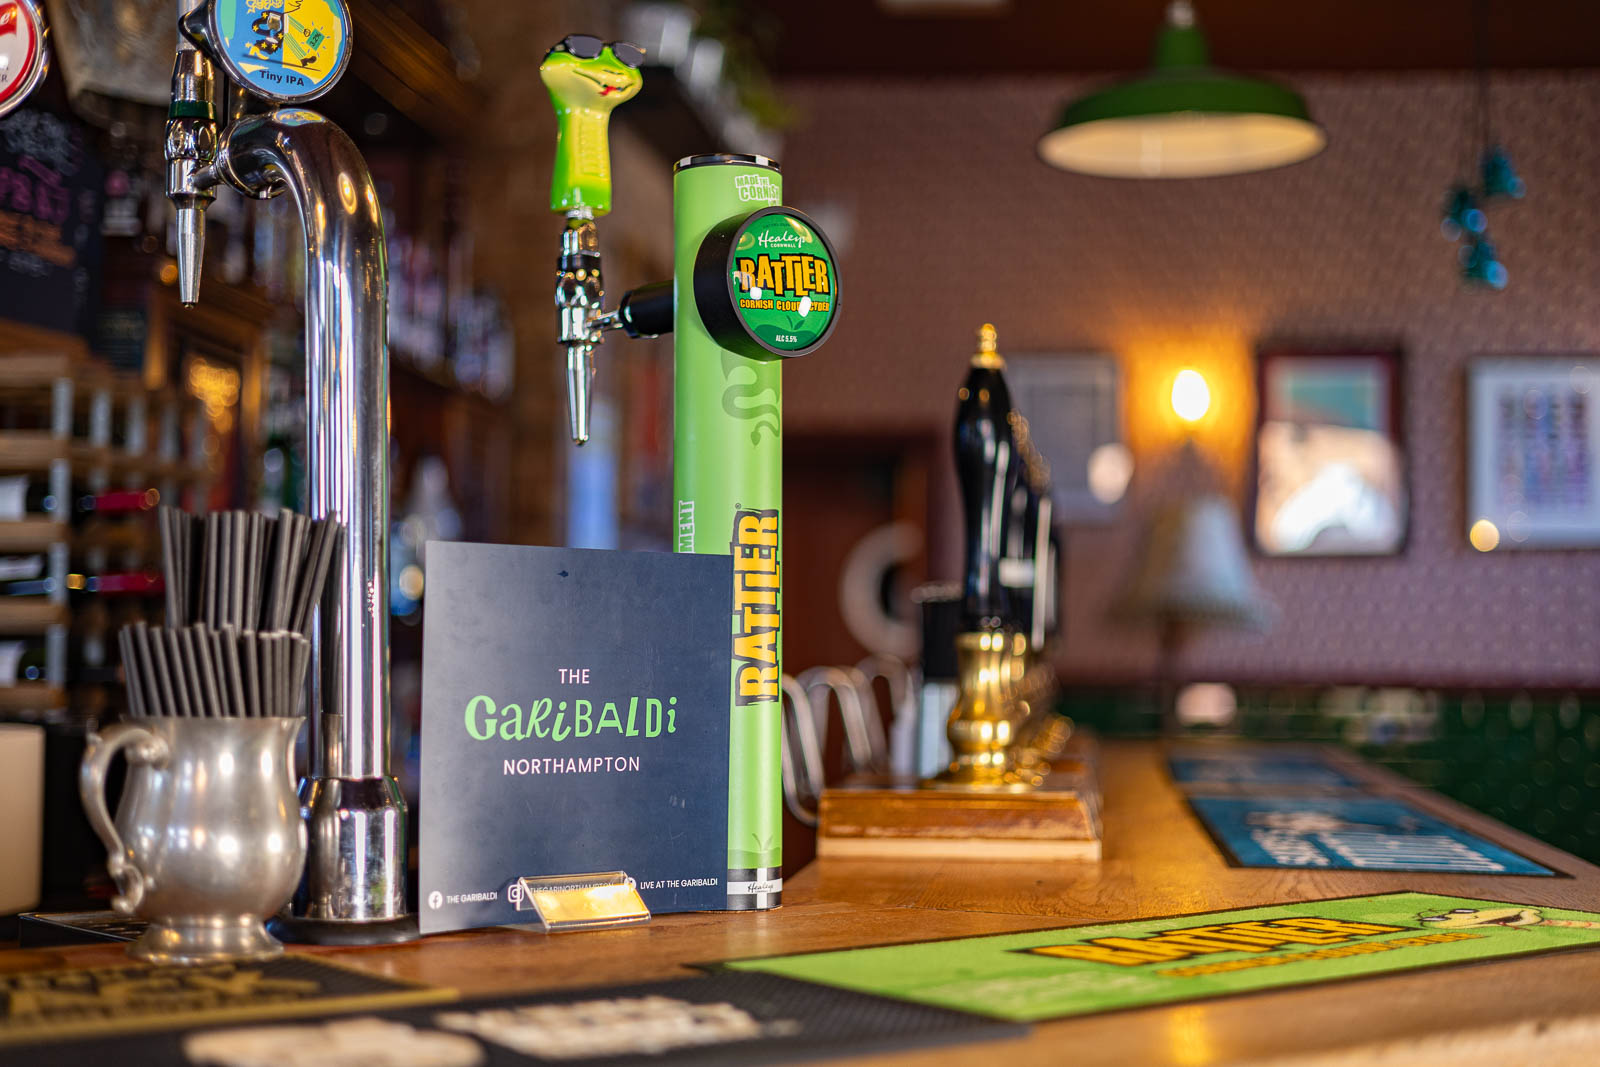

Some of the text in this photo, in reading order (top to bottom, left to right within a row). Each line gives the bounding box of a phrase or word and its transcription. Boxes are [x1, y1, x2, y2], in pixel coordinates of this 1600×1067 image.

[259, 70, 304, 86] Tiny IPA
[735, 174, 759, 188] MADE
[739, 184, 779, 201] CORNISH
[738, 254, 830, 297] RATTLER
[740, 299, 773, 309] CORNISH
[733, 509, 780, 706] RATTLER
[558, 669, 590, 684] THE
[503, 757, 640, 776] NORTHAMPTON
[640, 878, 718, 890] LIVE AT THE GARIBALDI
[446, 891, 498, 904] THE GARIBALDI
[1014, 917, 1418, 967] RATTLER
